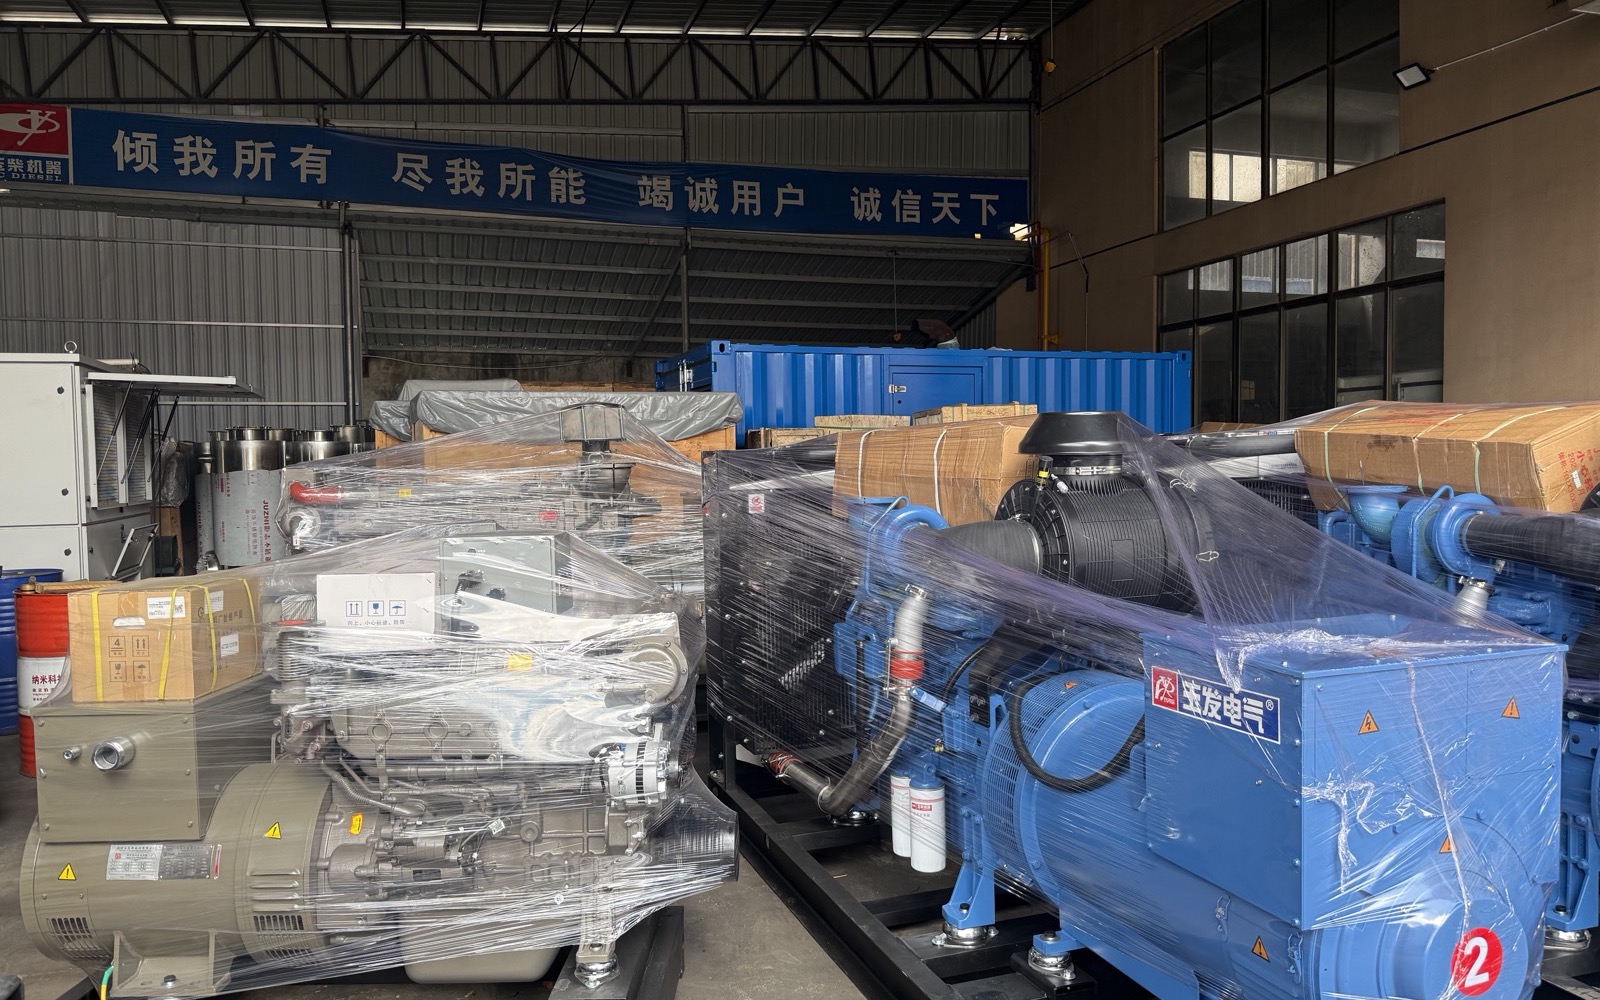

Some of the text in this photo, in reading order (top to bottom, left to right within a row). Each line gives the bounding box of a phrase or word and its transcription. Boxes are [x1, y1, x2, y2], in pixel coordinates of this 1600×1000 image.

[12, 172, 62, 182] DIESEL
[112, 129, 1000, 226] 倾我所有 尽我所能 竭诚用户 诚信天下
[114, 638, 121, 647] 4
[1464, 936, 1490, 988] 2
